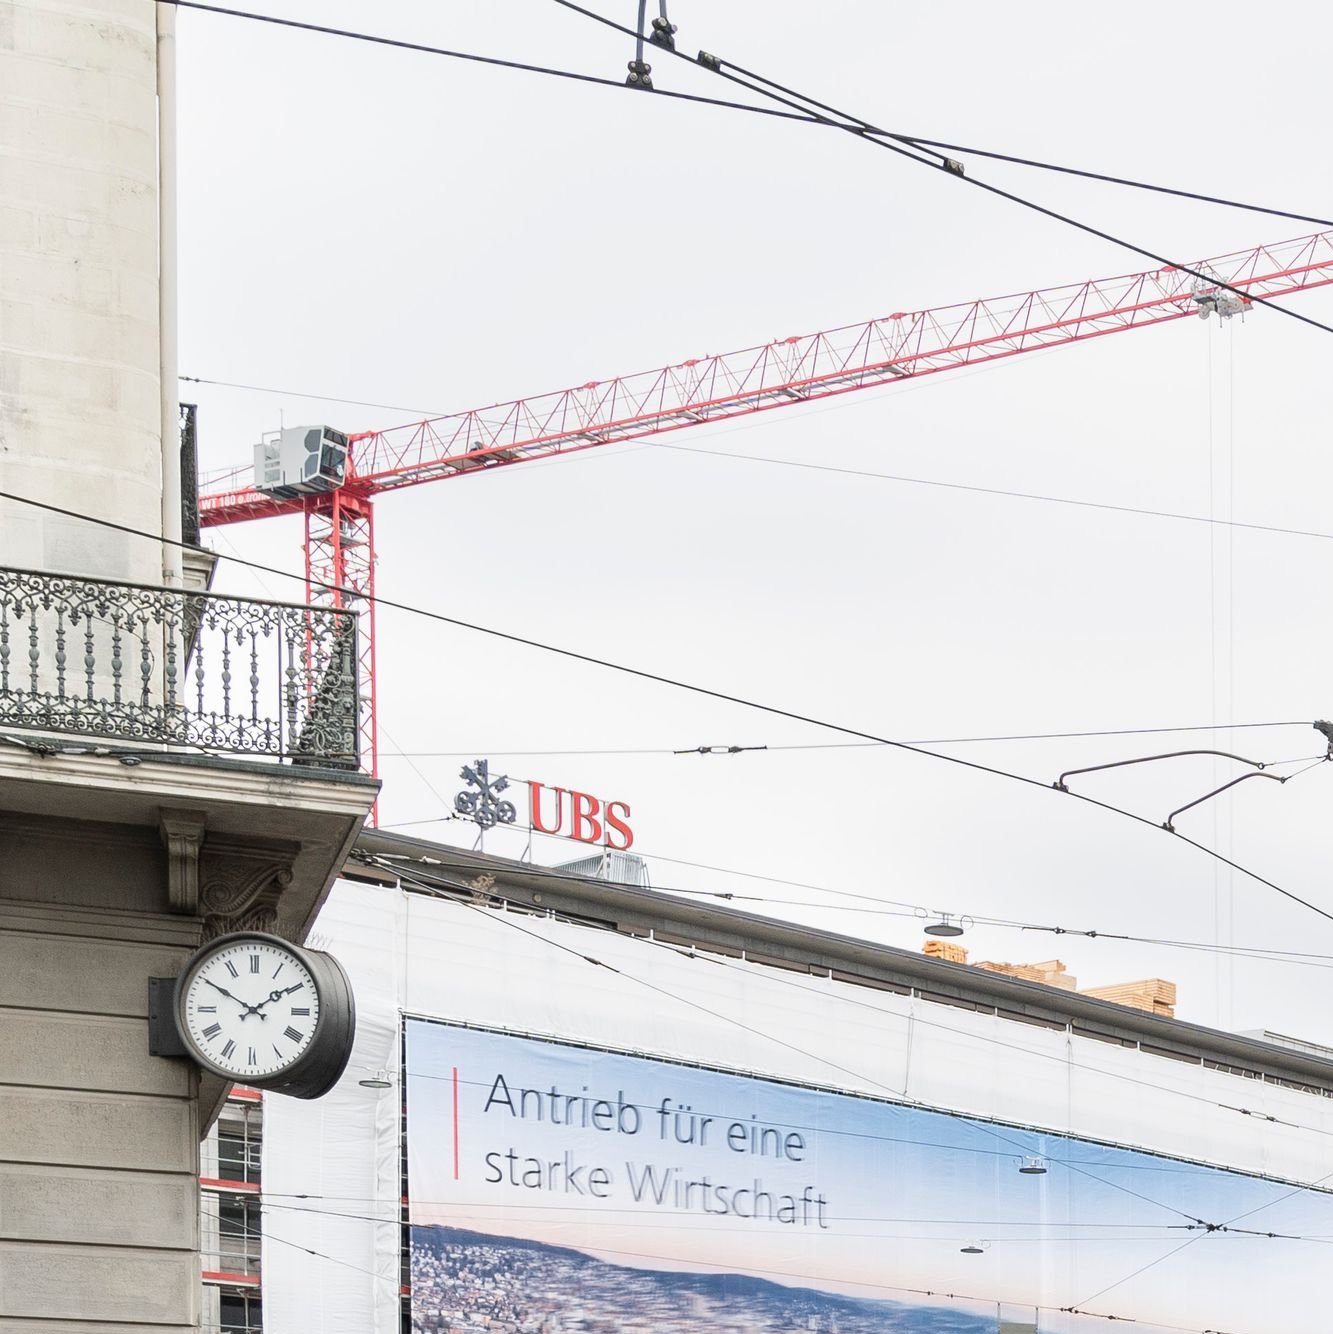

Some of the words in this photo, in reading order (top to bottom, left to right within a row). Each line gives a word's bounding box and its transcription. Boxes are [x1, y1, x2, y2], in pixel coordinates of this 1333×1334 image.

[527, 780, 634, 851] UBS
[484, 1073, 642, 1135] Antrieb
[656, 1097, 713, 1147] für
[726, 1113, 807, 1162] eine
[484, 1147, 614, 1199] starke
[625, 1160, 832, 1230] Wirtschaft
